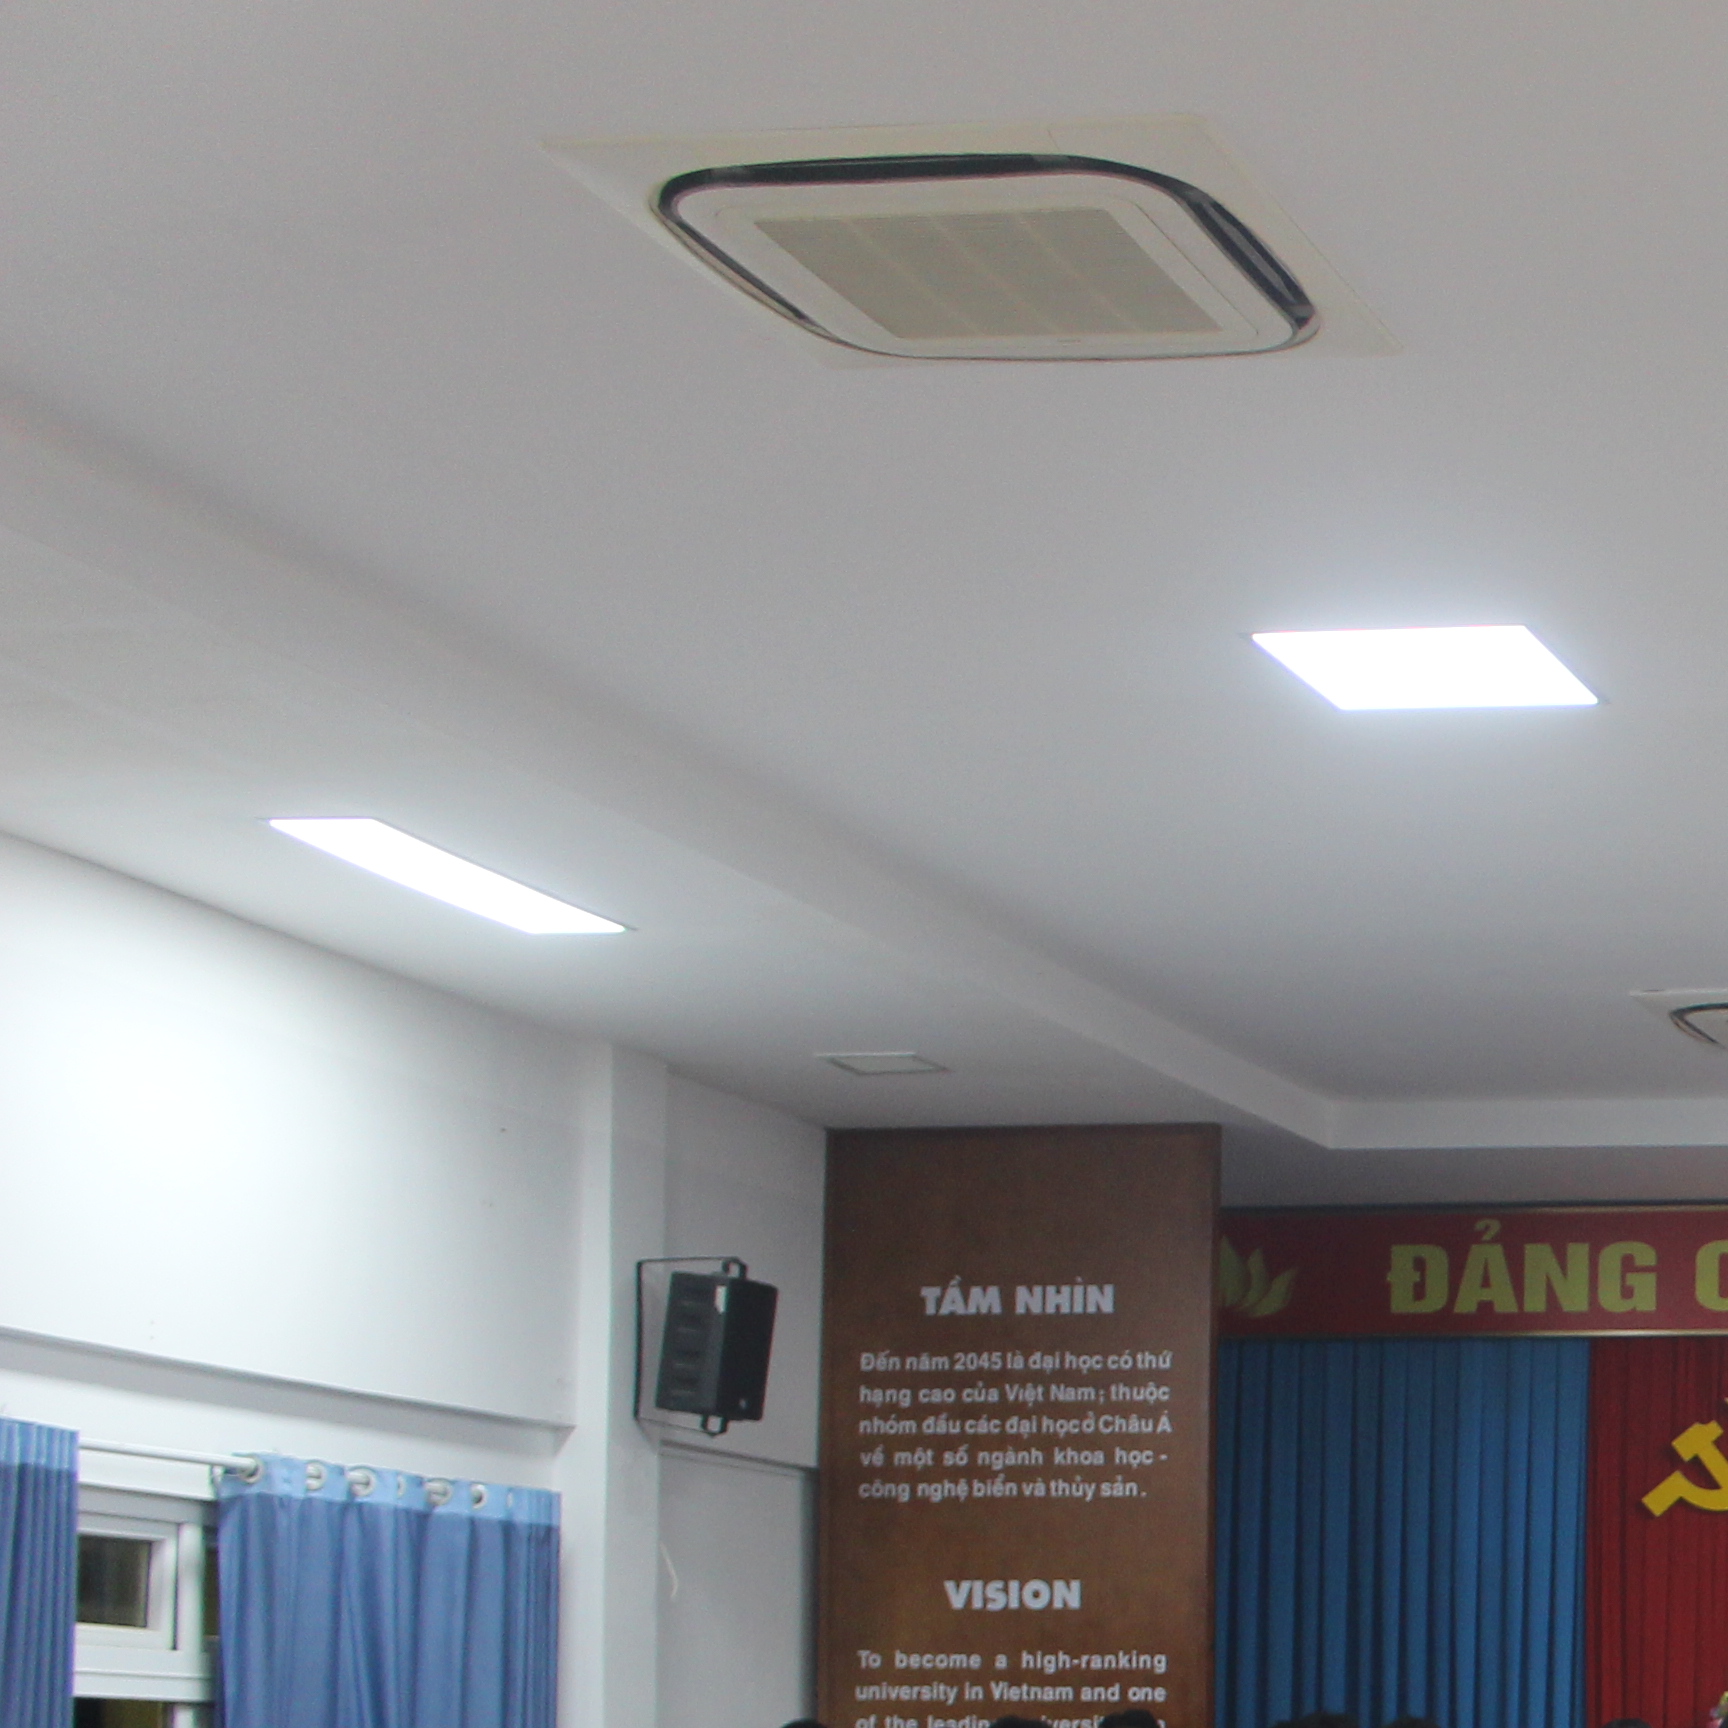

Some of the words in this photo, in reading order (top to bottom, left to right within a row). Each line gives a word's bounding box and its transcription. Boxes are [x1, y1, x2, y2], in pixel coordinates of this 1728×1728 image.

[1387, 1218, 1662, 1315] ĐẢNG
[1015, 1276, 1114, 1314] NHÌN
[953, 1351, 1001, 1370] 2045
[1006, 1349, 1023, 1370] là
[1028, 1351, 1060, 1374] đại
[1065, 1350, 1102, 1375] học
[1106, 1349, 1133, 1370] có
[859, 1384, 912, 1407] hạng
[918, 1388, 955, 1403] cao
[962, 1380, 999, 1403] của
[1005, 1382, 1044, 1407] Việt
[1111, 1382, 1170, 1404] thuộc
[859, 1413, 917, 1435] nhóm
[965, 1413, 1001, 1434] các
[1005, 1414, 1037, 1439] đại
[1098, 1413, 1153, 1434] Châu
[894, 1446, 934, 1470] một
[942, 1443, 969, 1466] số
[977, 1445, 1043, 1471] ngành
[1054, 1446, 1105, 1465] khoa
[1115, 1446, 1154, 1470] học
[858, 1478, 910, 1502] công
[917, 1478, 969, 1503] nghệ
[1022, 1477, 1046, 1497] và
[1050, 1475, 1097, 1501] thủy
[943, 1580, 1081, 1611] VISION
[857, 1650, 881, 1669] To
[894, 1649, 982, 1669] become
[994, 1653, 1008, 1669] a
[1021, 1650, 1168, 1674] high-ranking
[854, 1681, 959, 1705] university
[964, 1681, 984, 1701] in
[990, 1681, 1074, 1701] Vietnam
[1080, 1682, 1121, 1701] and
[1127, 1685, 1168, 1702] one
